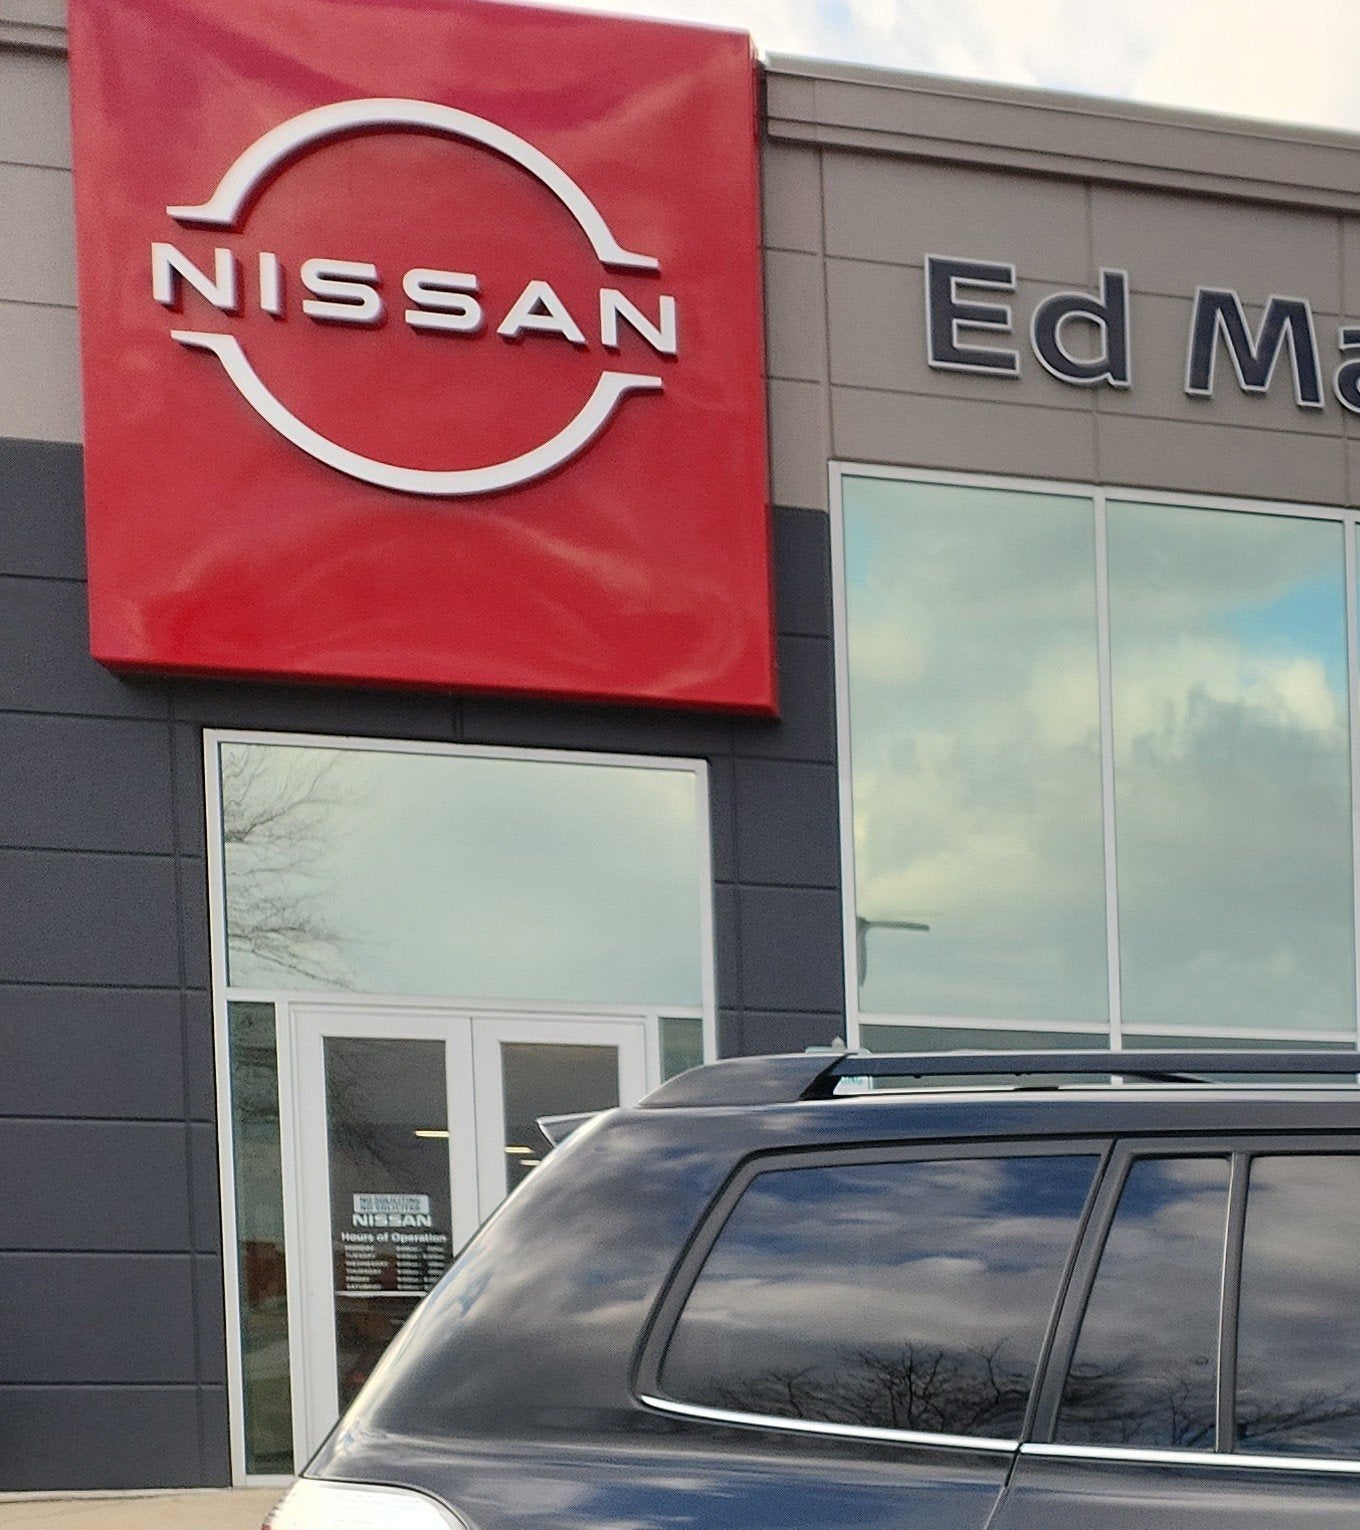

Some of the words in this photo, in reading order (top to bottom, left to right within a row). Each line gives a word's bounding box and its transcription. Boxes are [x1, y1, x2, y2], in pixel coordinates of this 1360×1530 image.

[151, 242, 678, 356] NISSAN
[924, 254, 1132, 389] Ed
[341, 1232, 374, 1242] Hours
[376, 1232, 389, 1242] of
[391, 1232, 447, 1243] Operation
[352, 1213, 432, 1227] NISSAN
